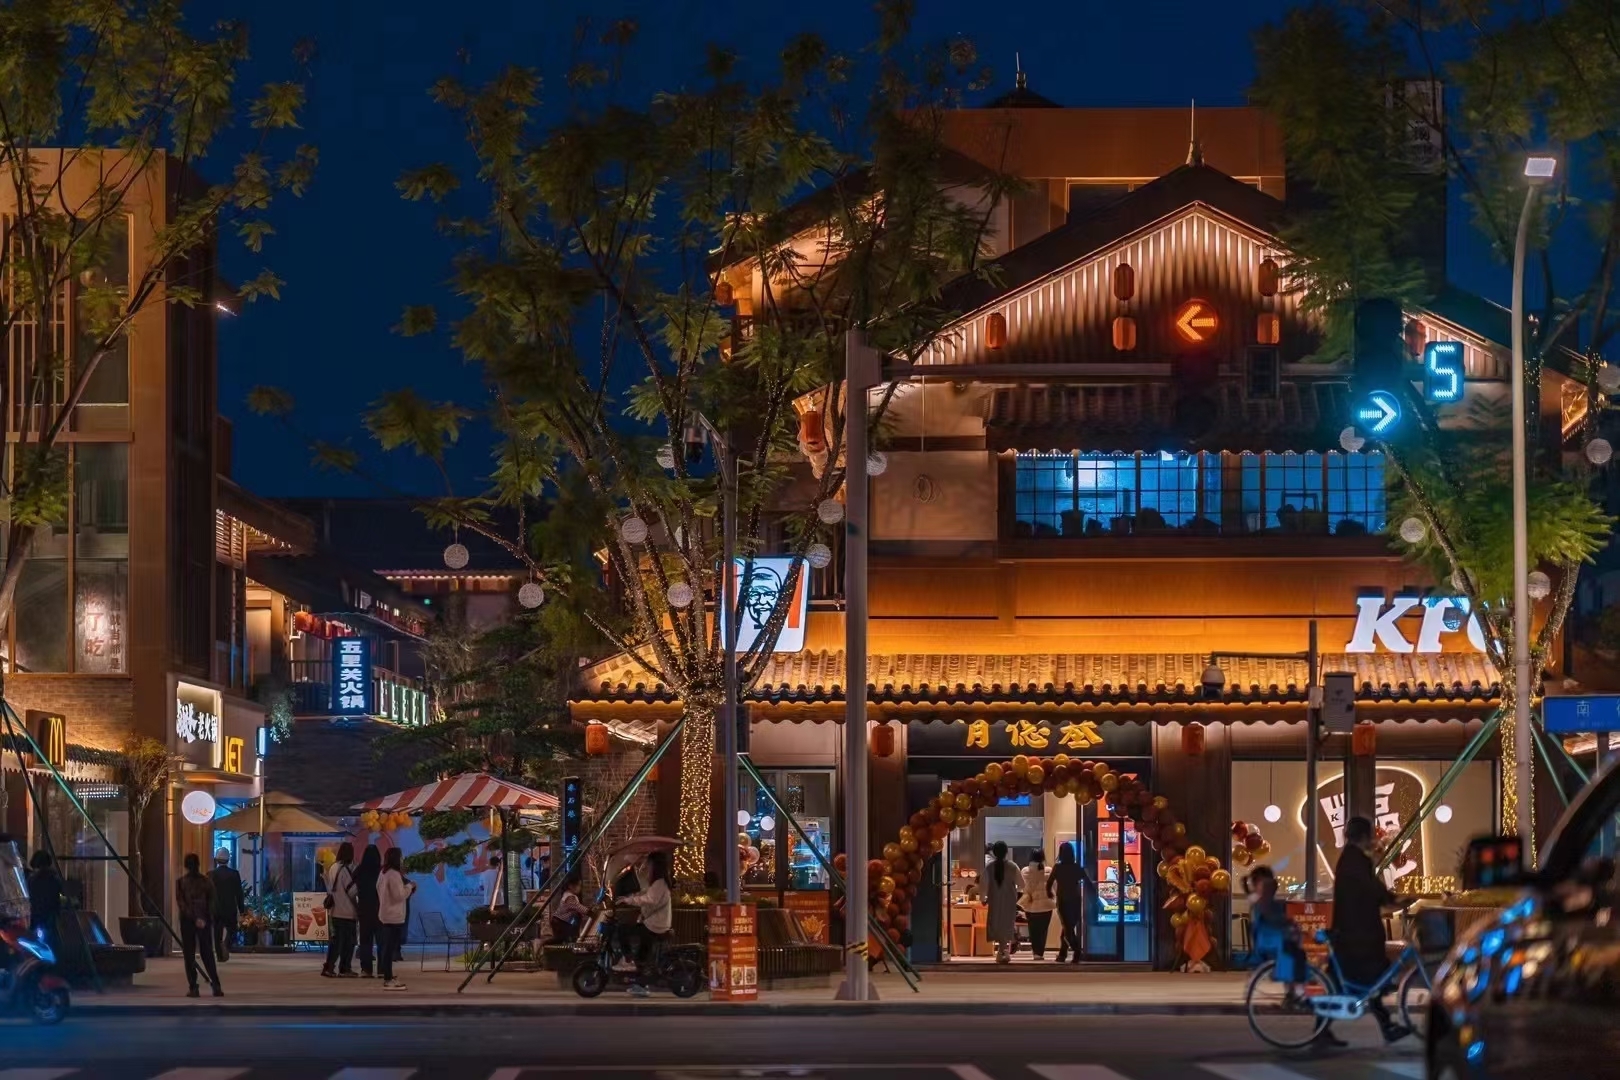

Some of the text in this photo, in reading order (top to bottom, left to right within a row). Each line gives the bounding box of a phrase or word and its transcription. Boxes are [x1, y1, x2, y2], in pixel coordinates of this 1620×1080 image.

[1430, 344, 1457, 398] 5
[339, 640, 364, 709] 五里关火锅
[223, 736, 244, 773] JET
